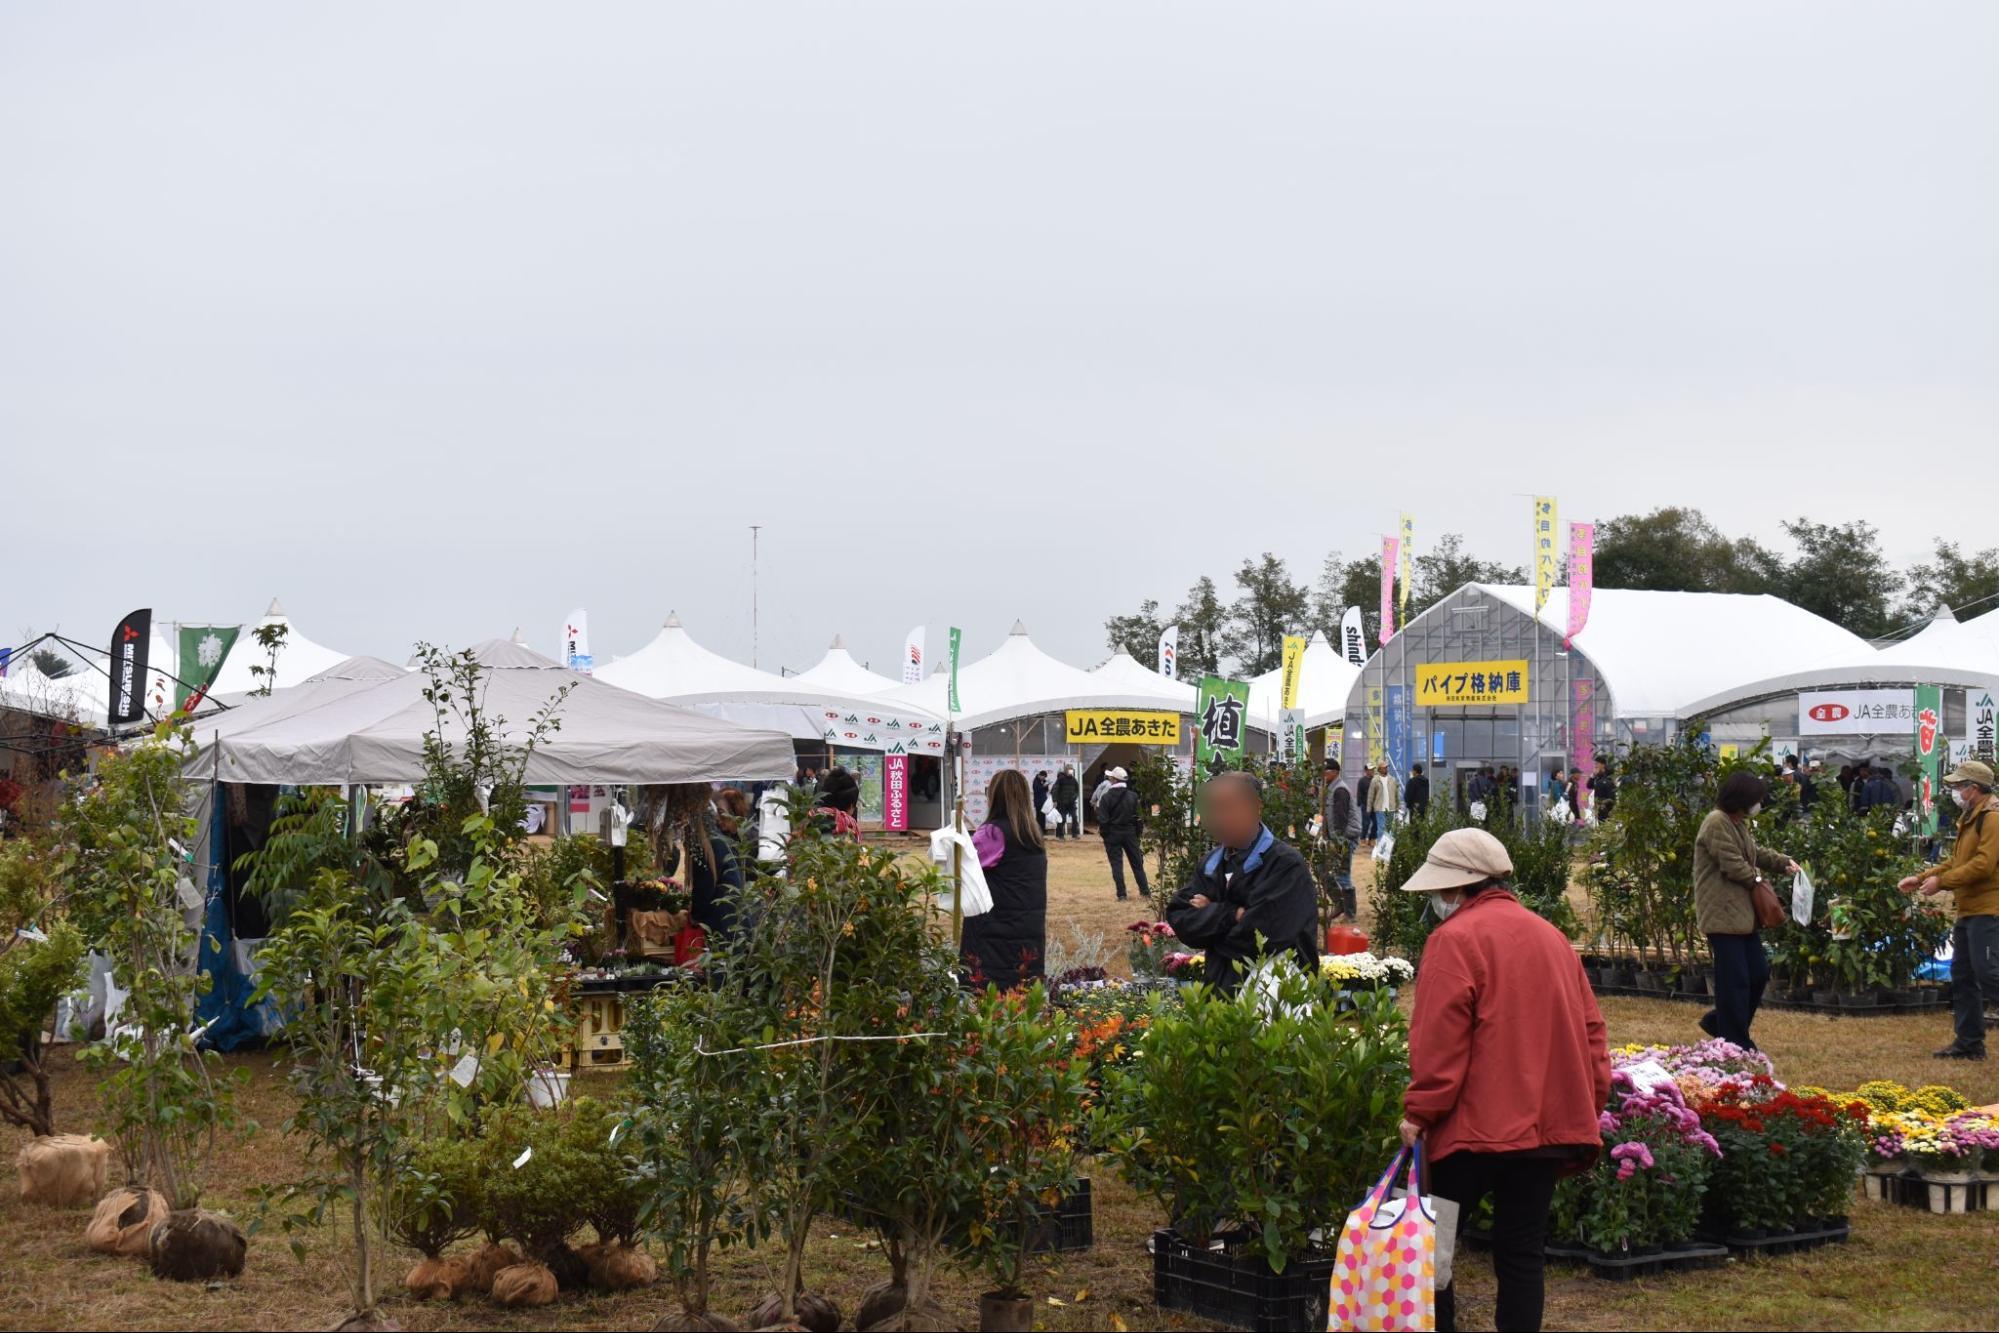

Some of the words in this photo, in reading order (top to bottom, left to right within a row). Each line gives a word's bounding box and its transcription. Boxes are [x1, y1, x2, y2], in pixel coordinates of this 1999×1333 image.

[1423, 670, 1521, 695] パイプ格納庫
[1070, 717, 1175, 737] JA全農あきた
[889, 758, 904, 827] JA秋田ふるさと
